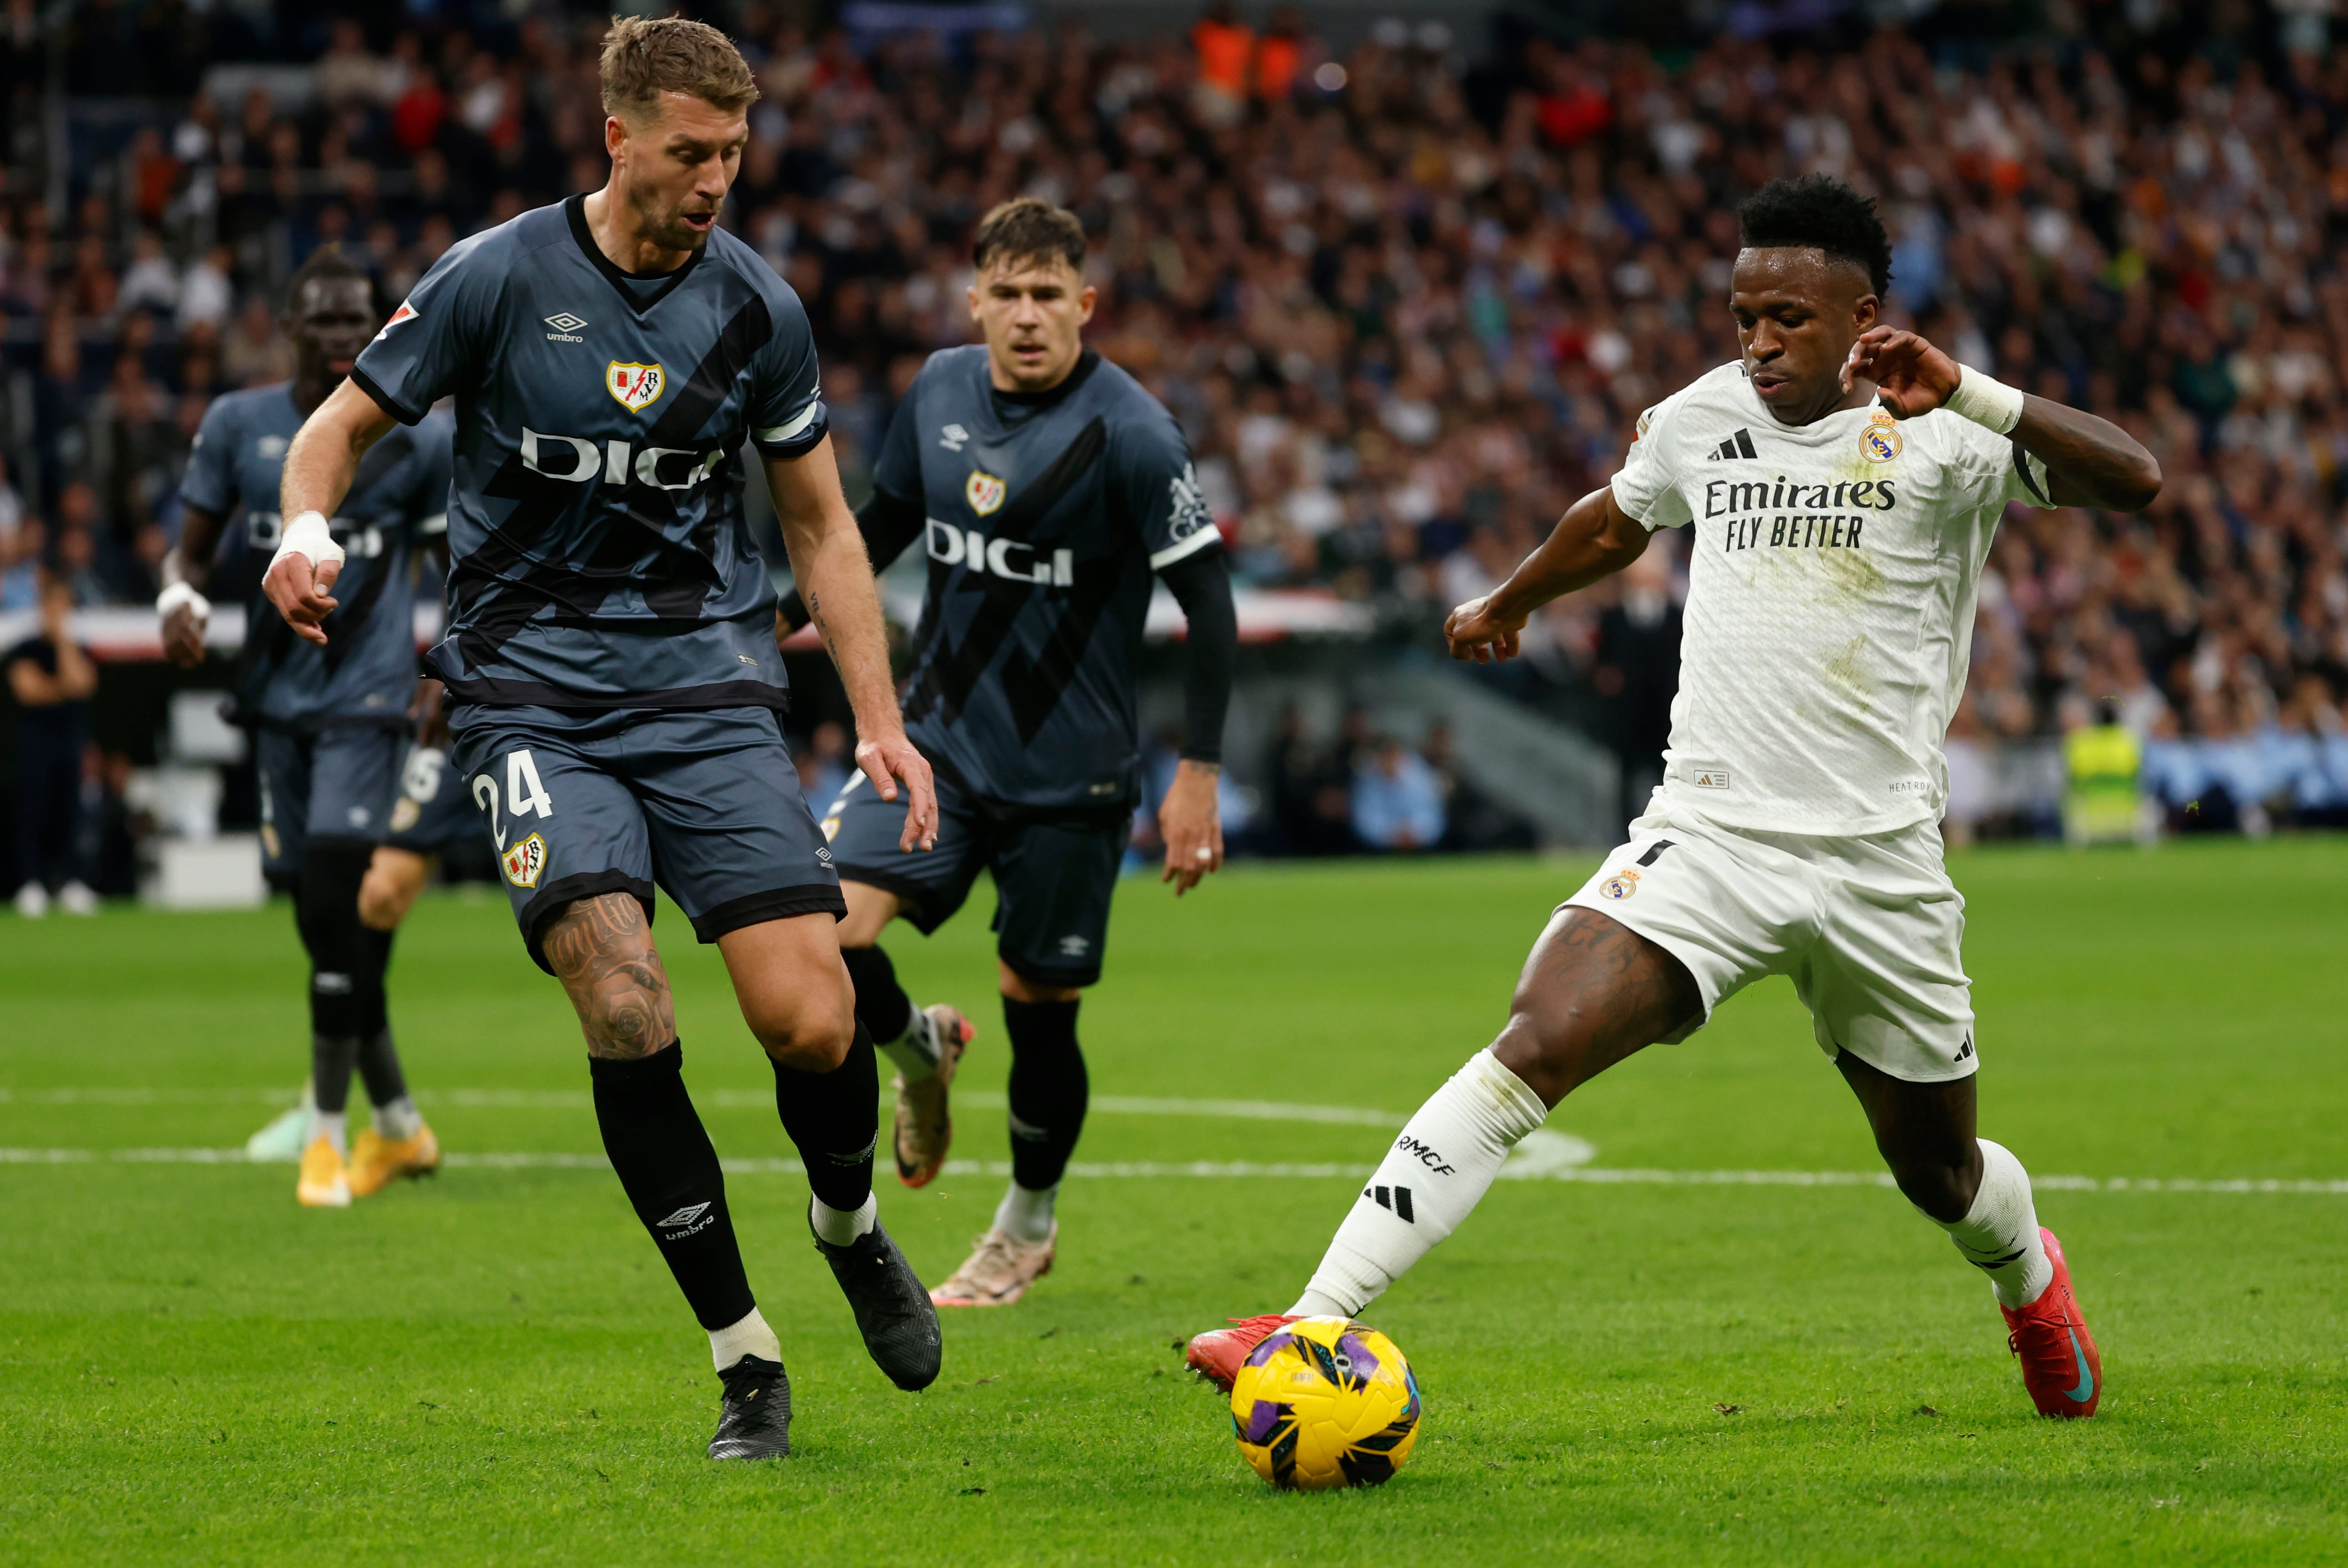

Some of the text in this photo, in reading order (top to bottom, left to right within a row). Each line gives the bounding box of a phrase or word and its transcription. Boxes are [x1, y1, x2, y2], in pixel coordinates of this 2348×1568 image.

[547, 333, 583, 343] umbro
[1706, 475, 1895, 519] Emirates
[926, 517, 1073, 586] DIGI
[1726, 515, 1863, 552] FLY BETTER
[472, 749, 553, 851] 24
[1395, 1135, 1456, 1176] RMCF
[665, 1215, 714, 1240] umbro
